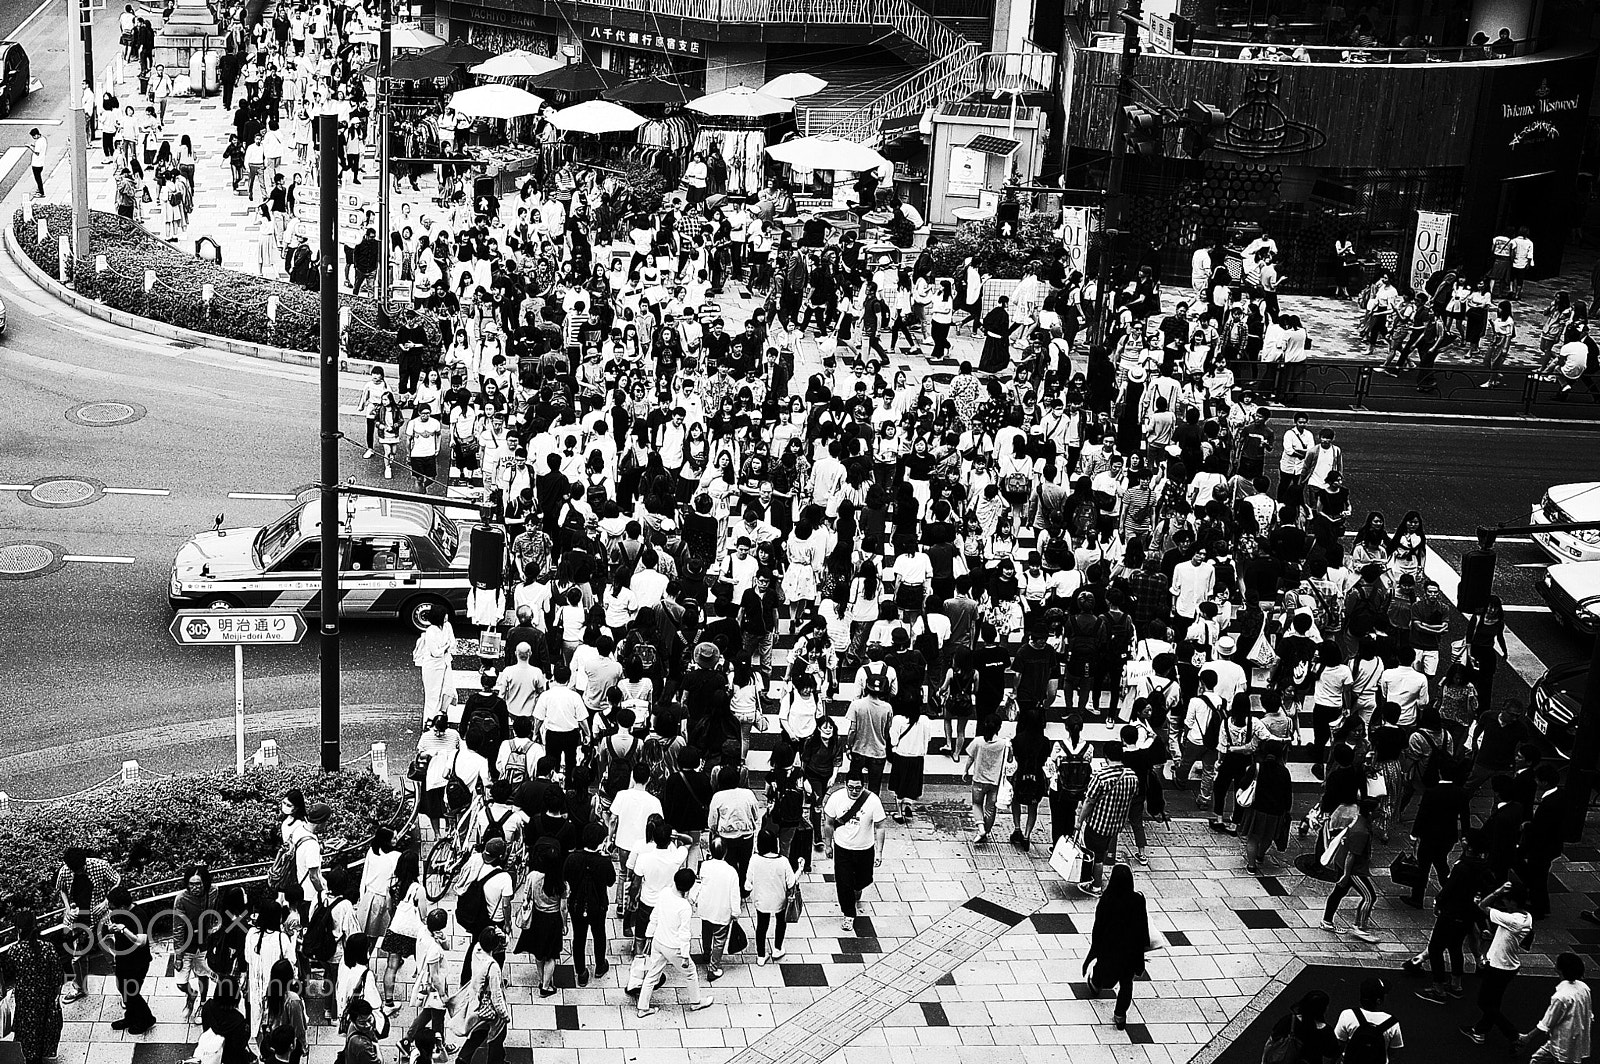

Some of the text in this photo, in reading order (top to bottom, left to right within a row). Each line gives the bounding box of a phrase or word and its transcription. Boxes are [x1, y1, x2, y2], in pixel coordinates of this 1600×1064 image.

[470, 8, 536, 27] YACHIYO BANK
[1501, 94, 1580, 118] Vivienne Westwood
[188, 623, 209, 635] 305
[218, 618, 286, 632] 明治通り
[222, 632, 283, 642] Meiji-dori Ave.
